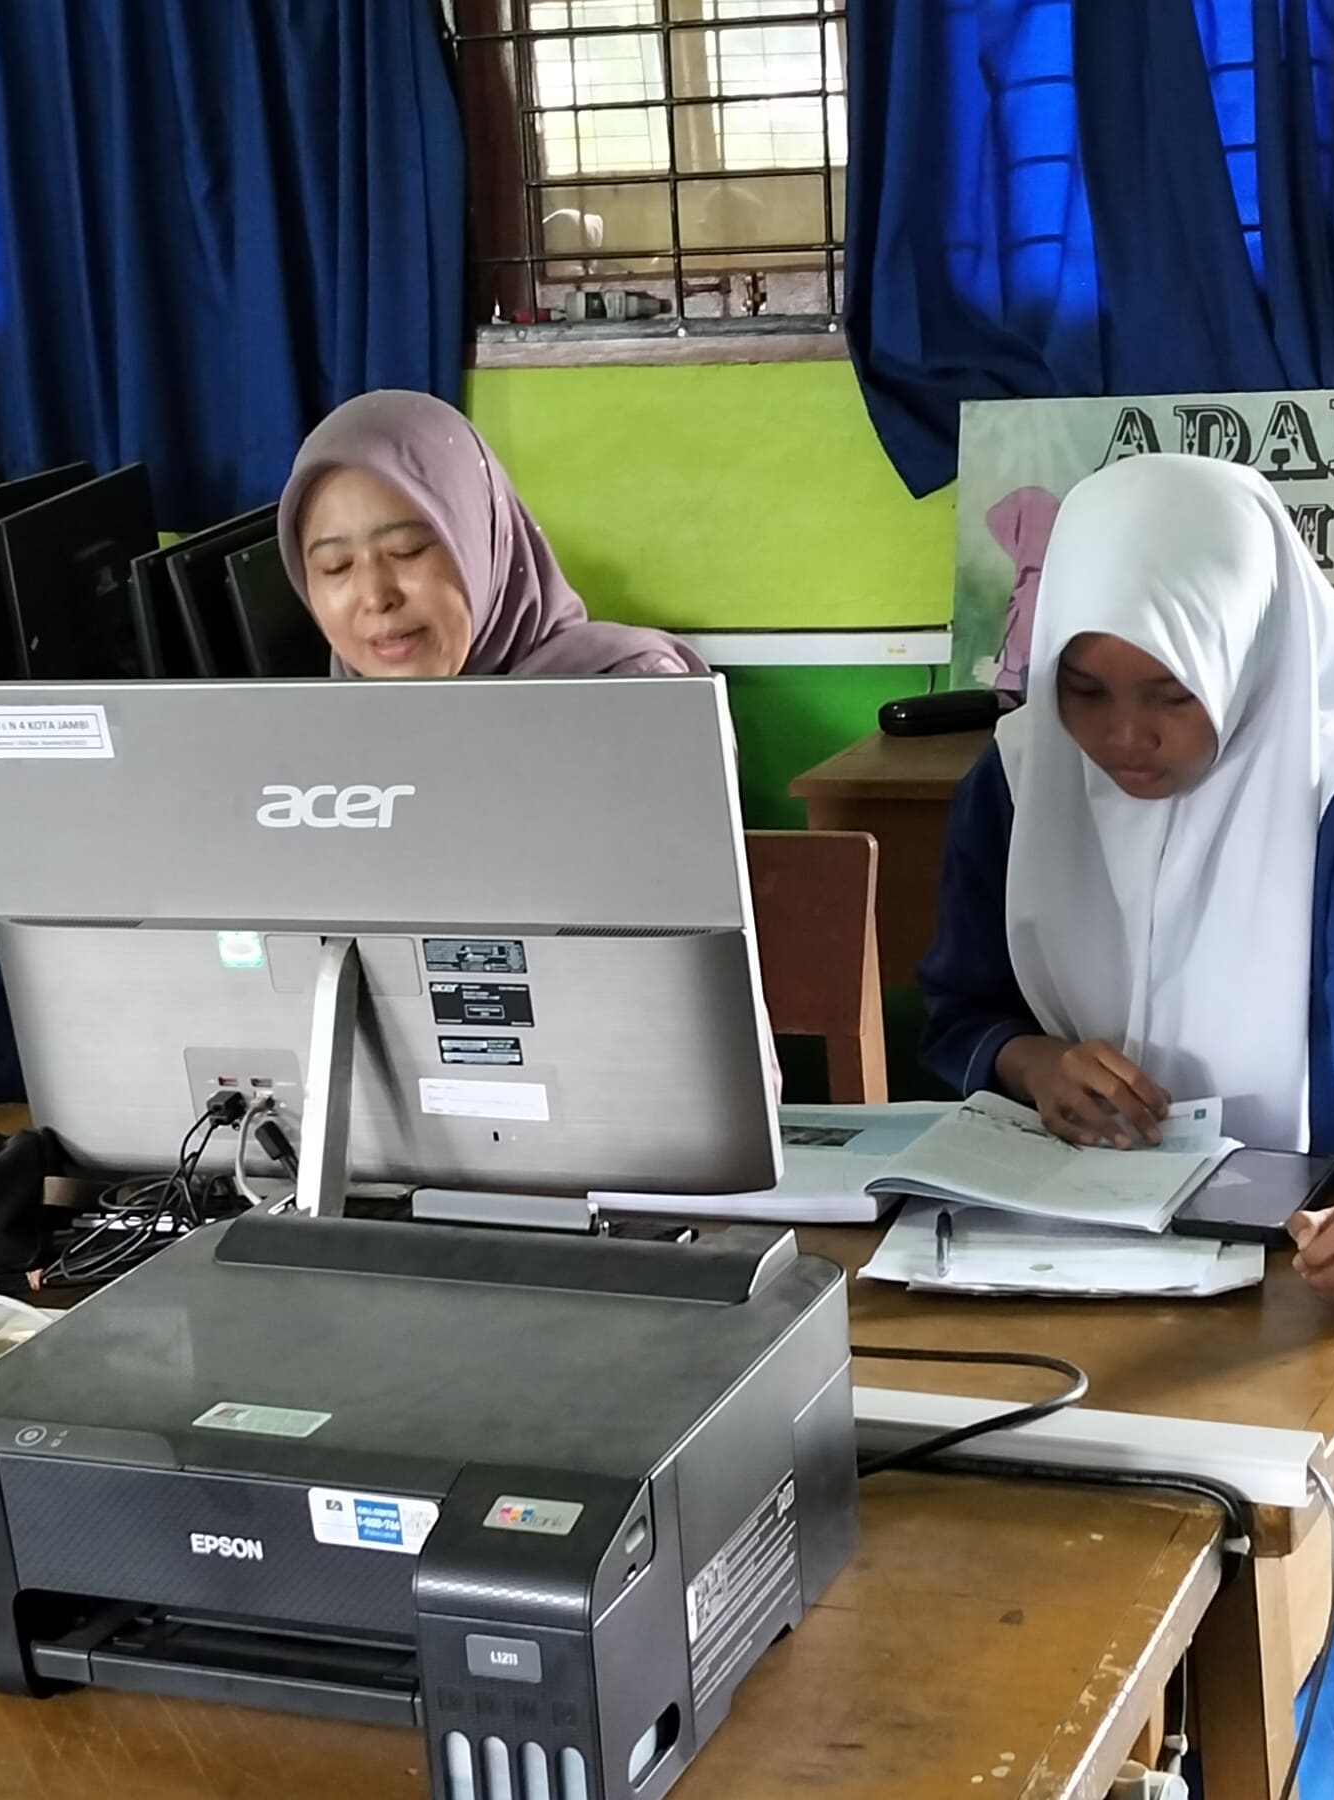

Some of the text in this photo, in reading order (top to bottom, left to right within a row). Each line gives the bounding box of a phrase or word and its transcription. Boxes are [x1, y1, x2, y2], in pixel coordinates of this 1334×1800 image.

[27, 720, 55, 730] KOTA
[58, 719, 89, 730] JAMBI
[256, 785, 415, 828] acer
[190, 1532, 264, 1561] EPSON
